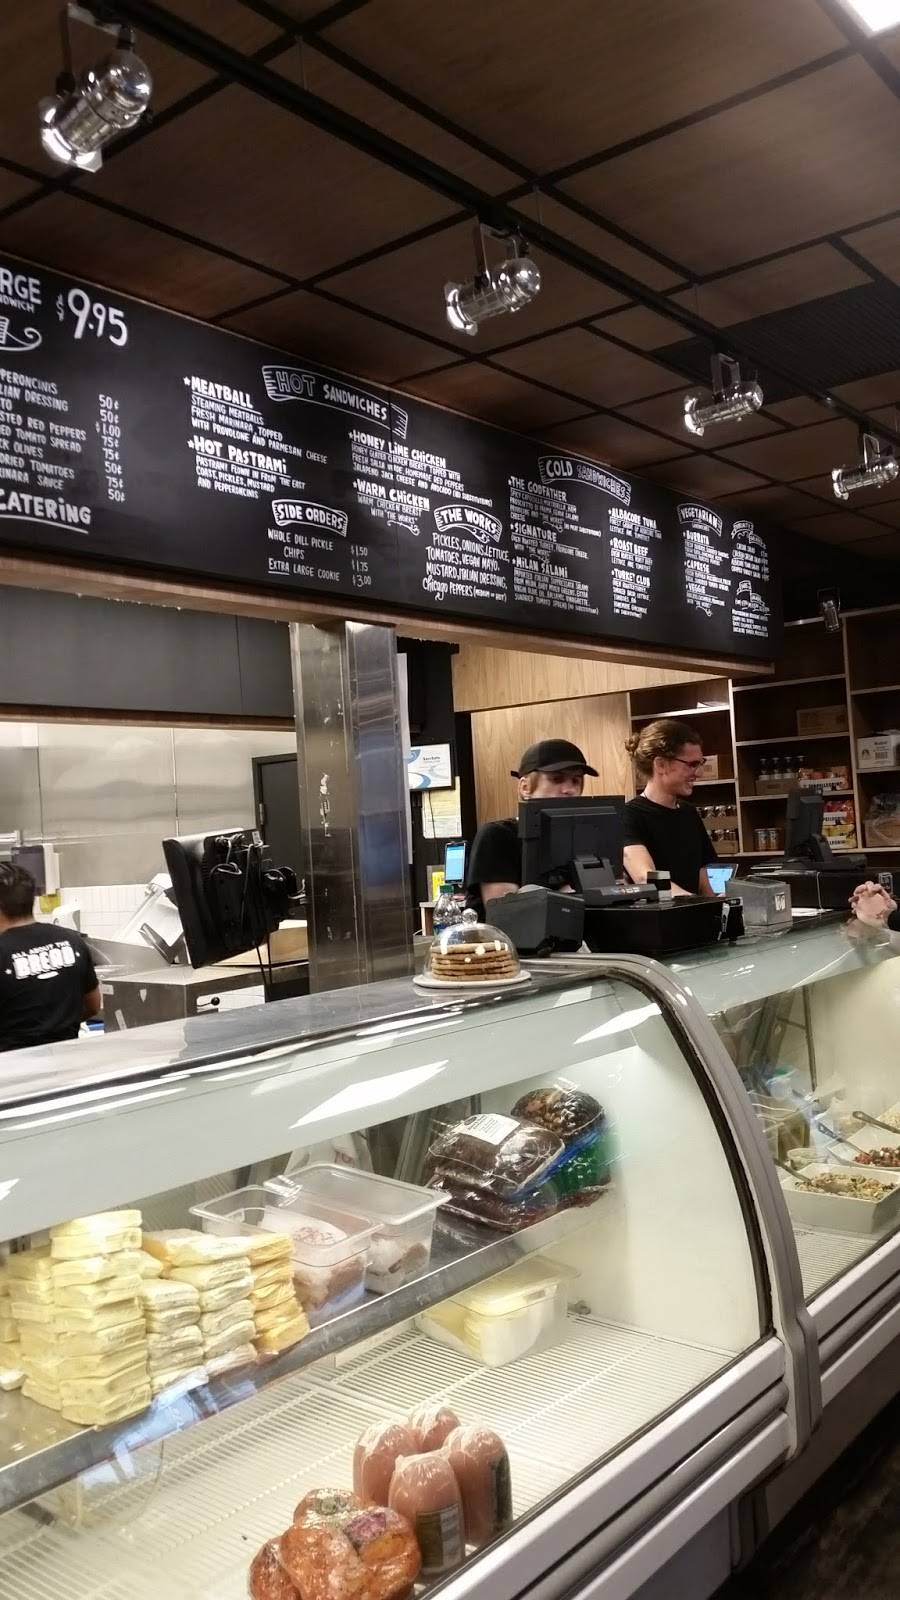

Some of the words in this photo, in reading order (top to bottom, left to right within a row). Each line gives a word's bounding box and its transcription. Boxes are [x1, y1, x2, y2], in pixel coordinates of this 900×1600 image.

[25, 389, 69, 412] DRESSING
[191, 376, 254, 409] MEATBALL
[276, 371, 315, 397] HOT
[323, 383, 388, 421] SANDWICHES
[192, 394, 228, 415] STEAMING
[229, 407, 265, 426] MEATBALLS
[27, 416, 45, 432] RED
[49, 422, 87, 441] PEPPERS
[192, 405, 215, 423] FRESH
[258, 426, 283, 444] TOPPED
[13, 441, 44, 459] OLIVES
[15, 428, 47, 445] TOMATO
[50, 436, 82, 453] SPREAD
[192, 418, 210, 432] WITH
[213, 425, 250, 443] PROVOLONE
[252, 437, 266, 448] AND
[268, 440, 302, 459] PARMESAN
[305, 449, 328, 464] CHEESE
[193, 435, 223, 457] HOT
[353, 429, 385, 451] HONEY
[30, 459, 75, 480] TOMATOES
[196, 455, 228, 472] PASTRAMI
[230, 464, 251, 479] FLOWN
[252, 468, 259, 480] IN
[260, 470, 277, 483] FROM
[280, 475, 291, 487] THE
[292, 478, 306, 490] EAST
[546, 460, 574, 478] COLD
[37, 474, 64, 491] SAUCE
[197, 477, 212, 489] AND
[247, 478, 275, 493] MUSTARD
[356, 478, 387, 499] WARM
[510, 475, 525, 491] THE
[527, 481, 568, 502] GODFATHER
[277, 504, 304, 520] SIDE
[305, 508, 344, 530] ORDERS
[440, 508, 463, 524] THE
[464, 509, 497, 534] WORKS
[611, 507, 642, 526] ALBACORE
[642, 516, 657, 530] TUNA
[680, 507, 718, 528] VEGETARIAN
[267, 528, 291, 542] WHOLE
[294, 534, 309, 546] DILL
[311, 537, 334, 551] PICKLE
[514, 522, 557, 543] SIGNATURE
[283, 546, 305, 561] CHIPS
[613, 537, 633, 552] ROAST
[634, 543, 649, 557] BEEF
[268, 558, 290, 573] EXTRA
[293, 564, 315, 577] LARGE
[317, 568, 341, 582] COOKIE
[462, 553, 481, 569] VEGAN
[686, 559, 710, 574] CAPRESE
[614, 568, 635, 581] TURKEY
[636, 575, 651, 588] CLUB
[449, 581, 473, 598] PEPPERS
